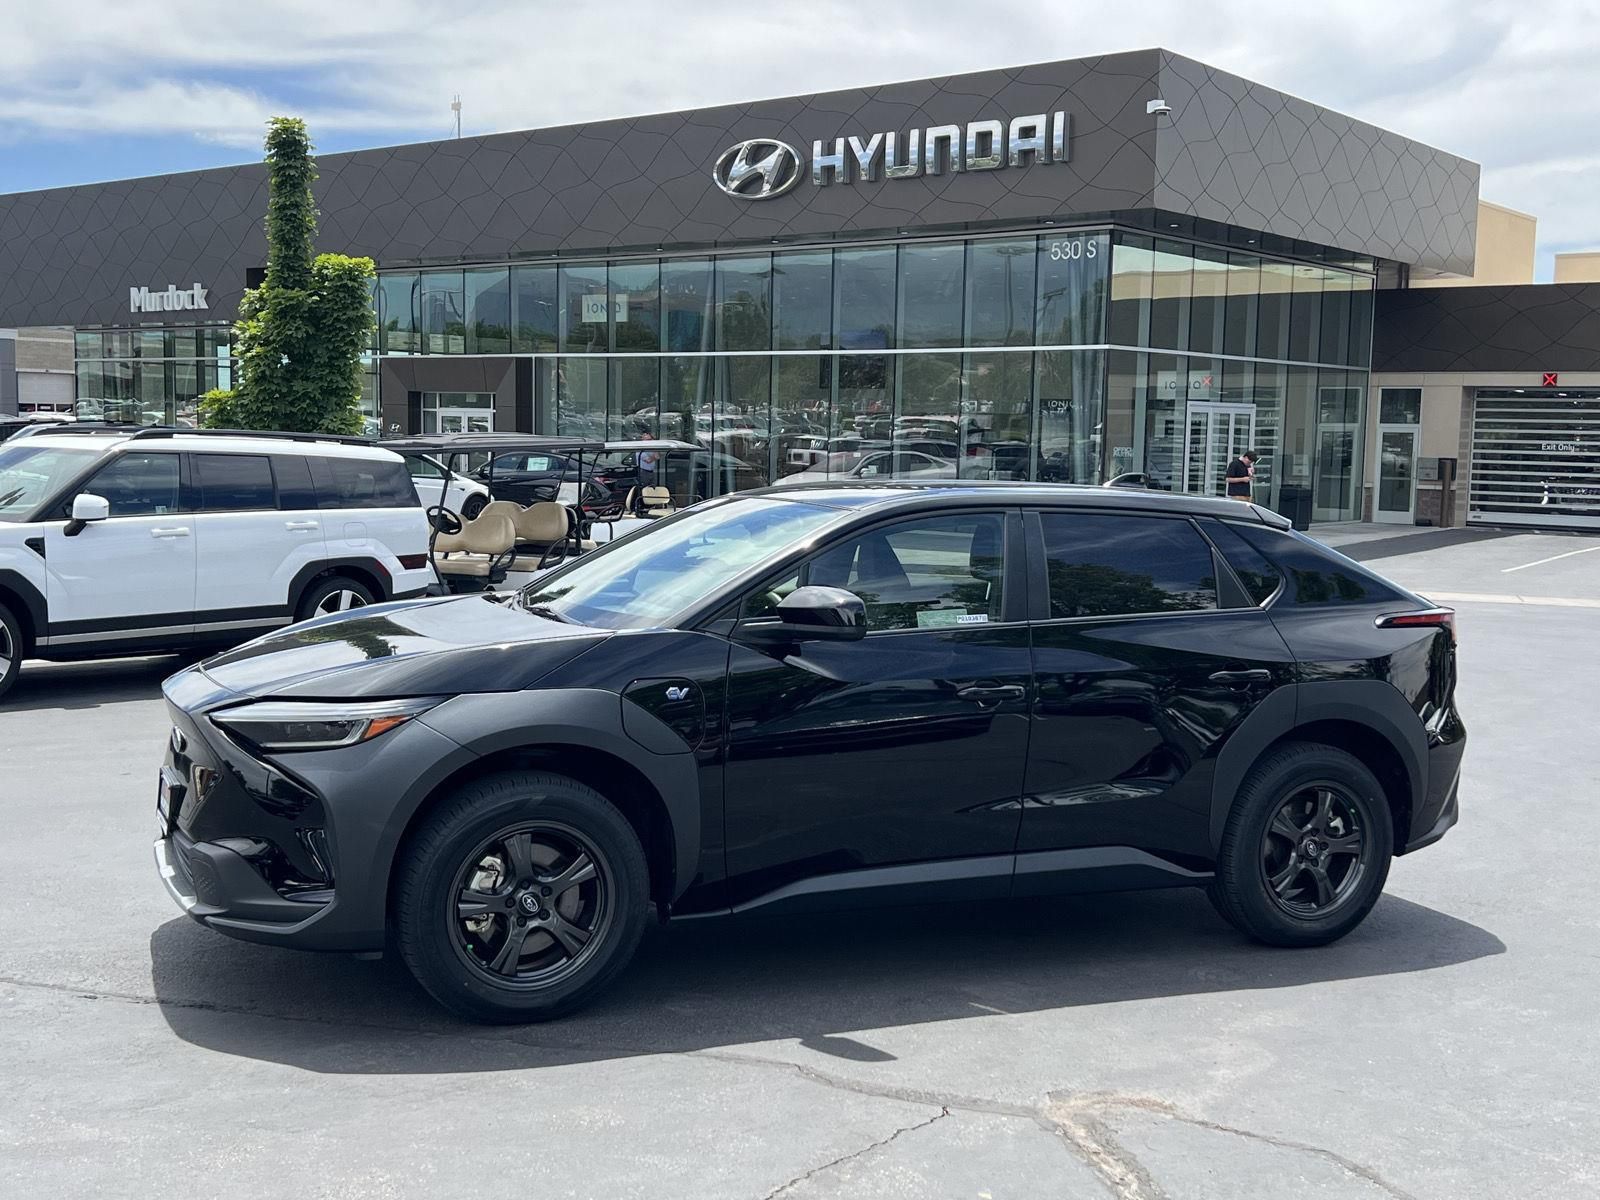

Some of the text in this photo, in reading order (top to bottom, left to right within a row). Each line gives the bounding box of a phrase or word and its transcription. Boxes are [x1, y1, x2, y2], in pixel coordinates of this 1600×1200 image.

[812, 110, 1070, 186] HYUNDAI
[1050, 239, 1097, 261] 530 S
[129, 282, 209, 313] Murdock
[1541, 442, 1576, 454] Exit Only
